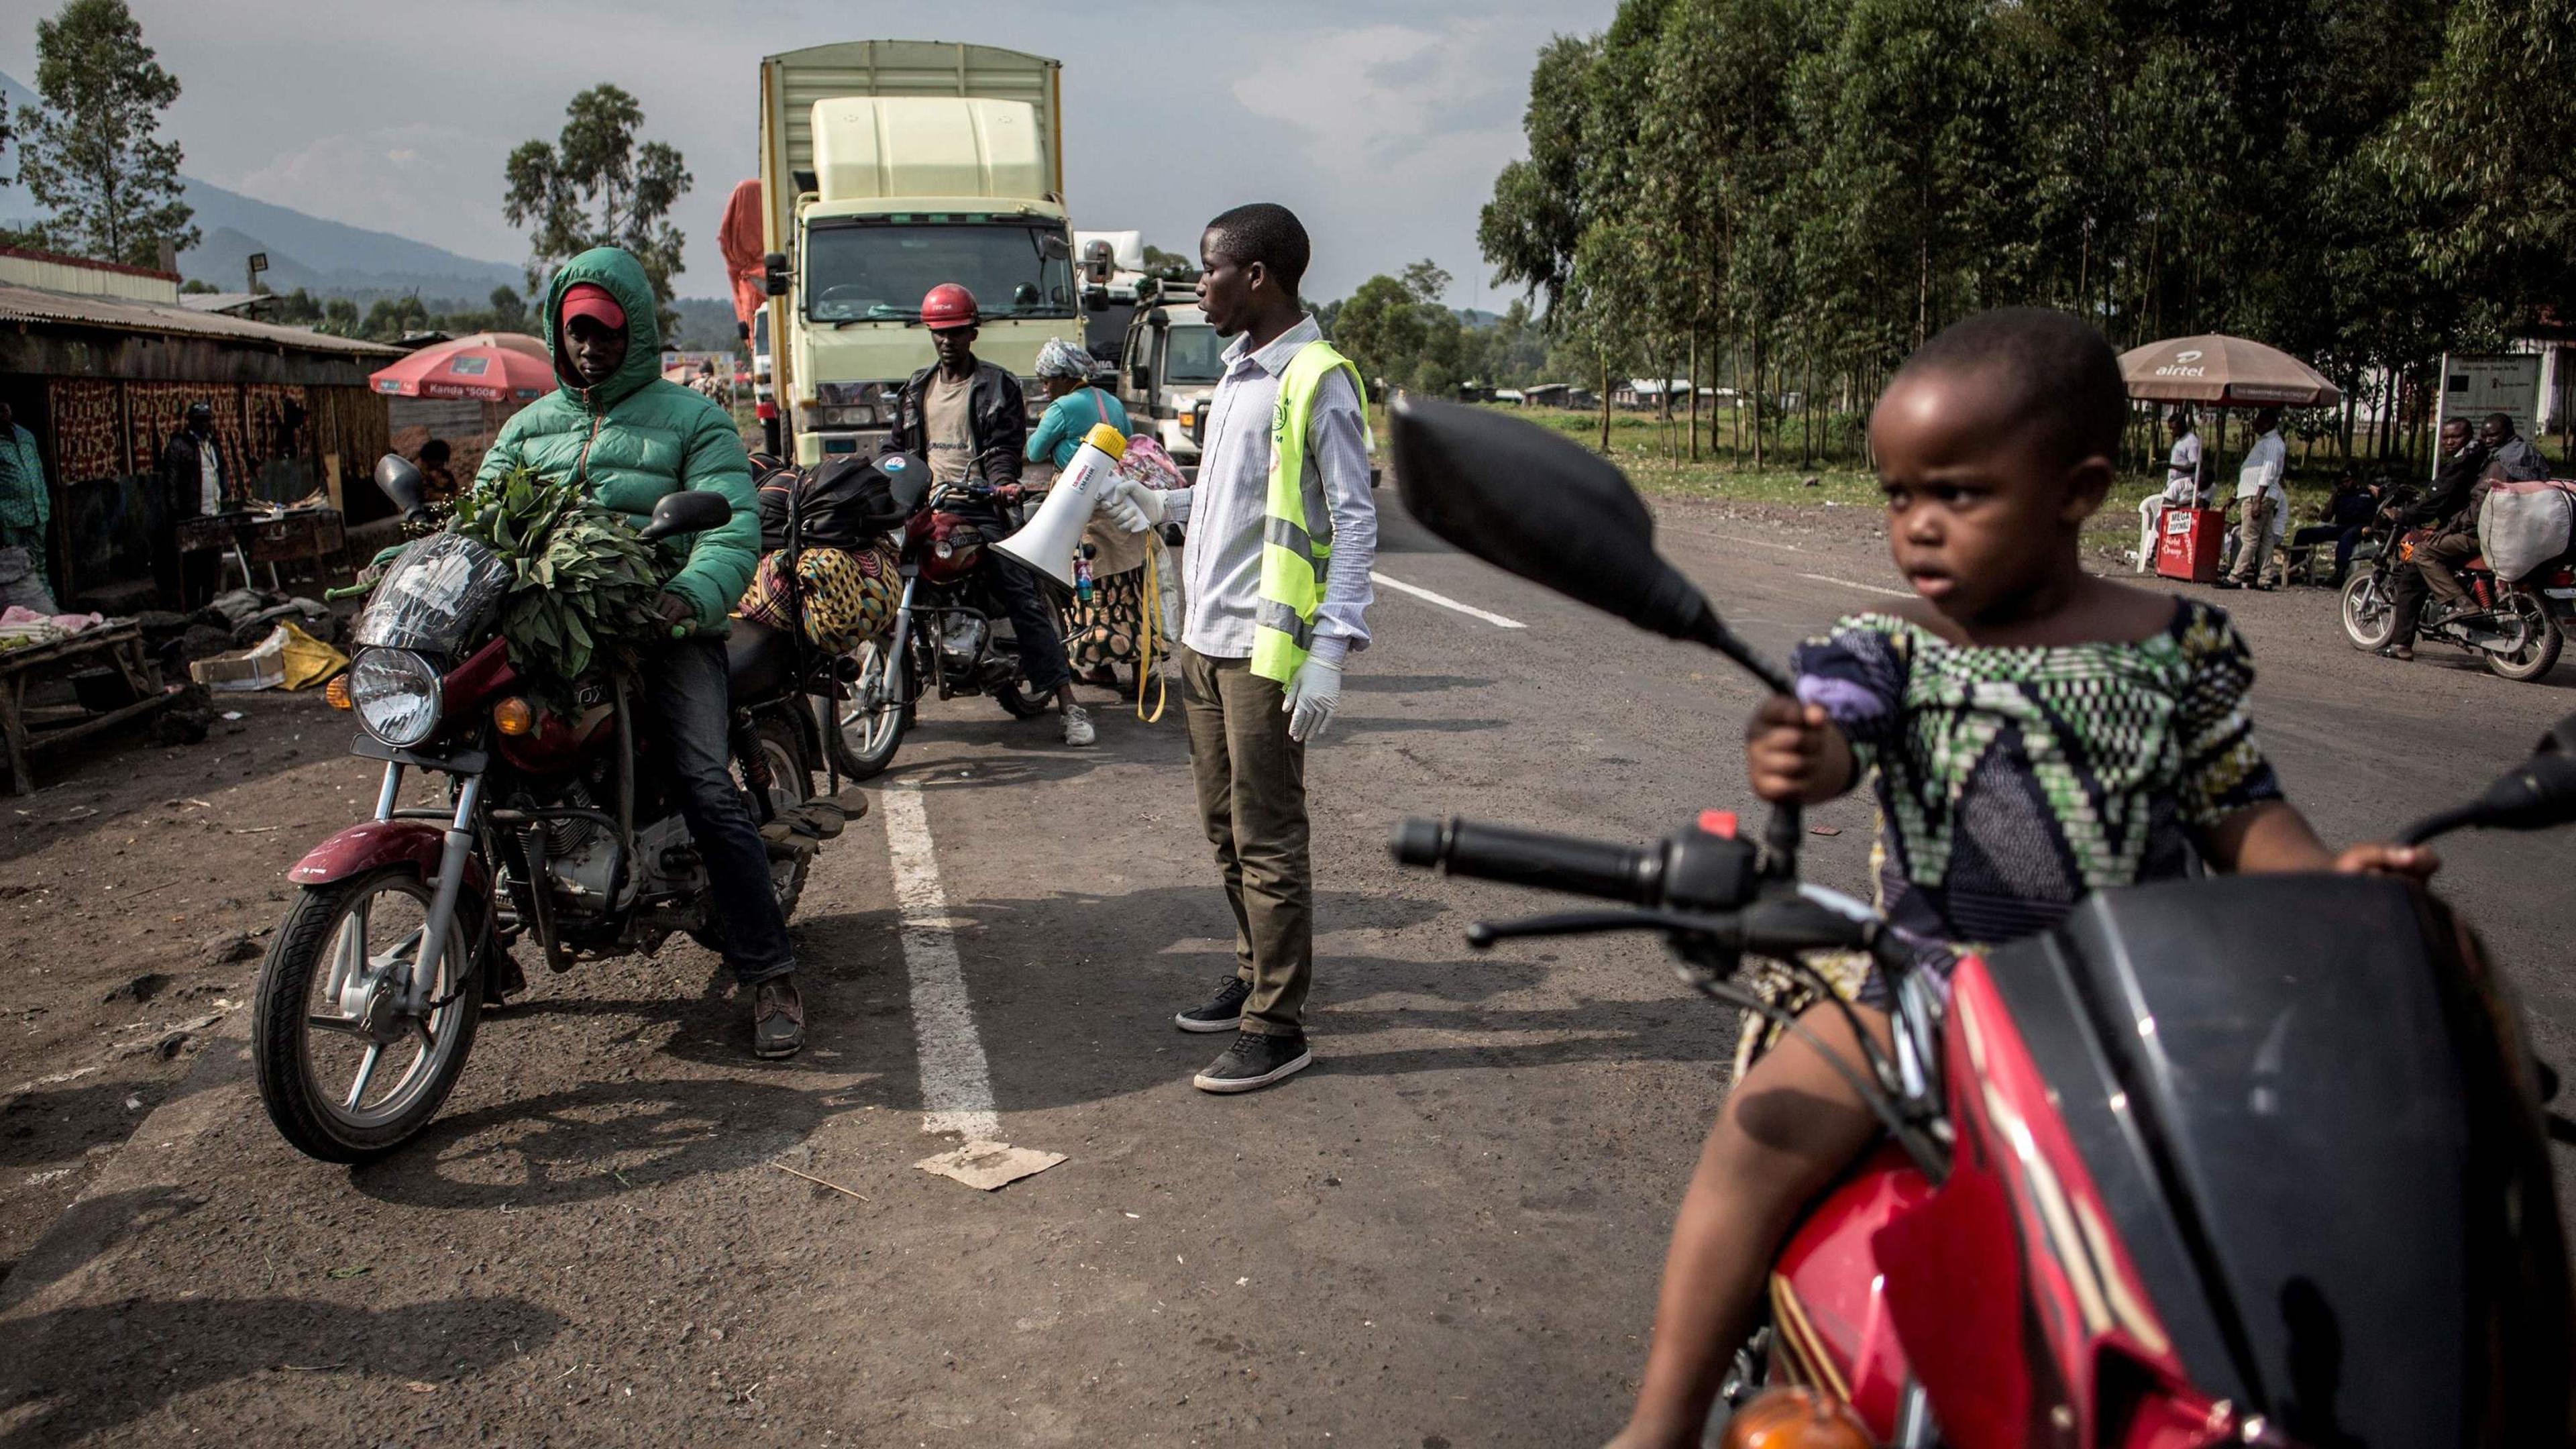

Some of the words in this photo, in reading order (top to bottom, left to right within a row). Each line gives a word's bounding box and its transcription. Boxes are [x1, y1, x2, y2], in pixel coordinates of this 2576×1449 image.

[2155, 364, 2204, 377] airtel
[429, 383, 463, 396] Kanda
[2171, 513, 2190, 521] MEGA
